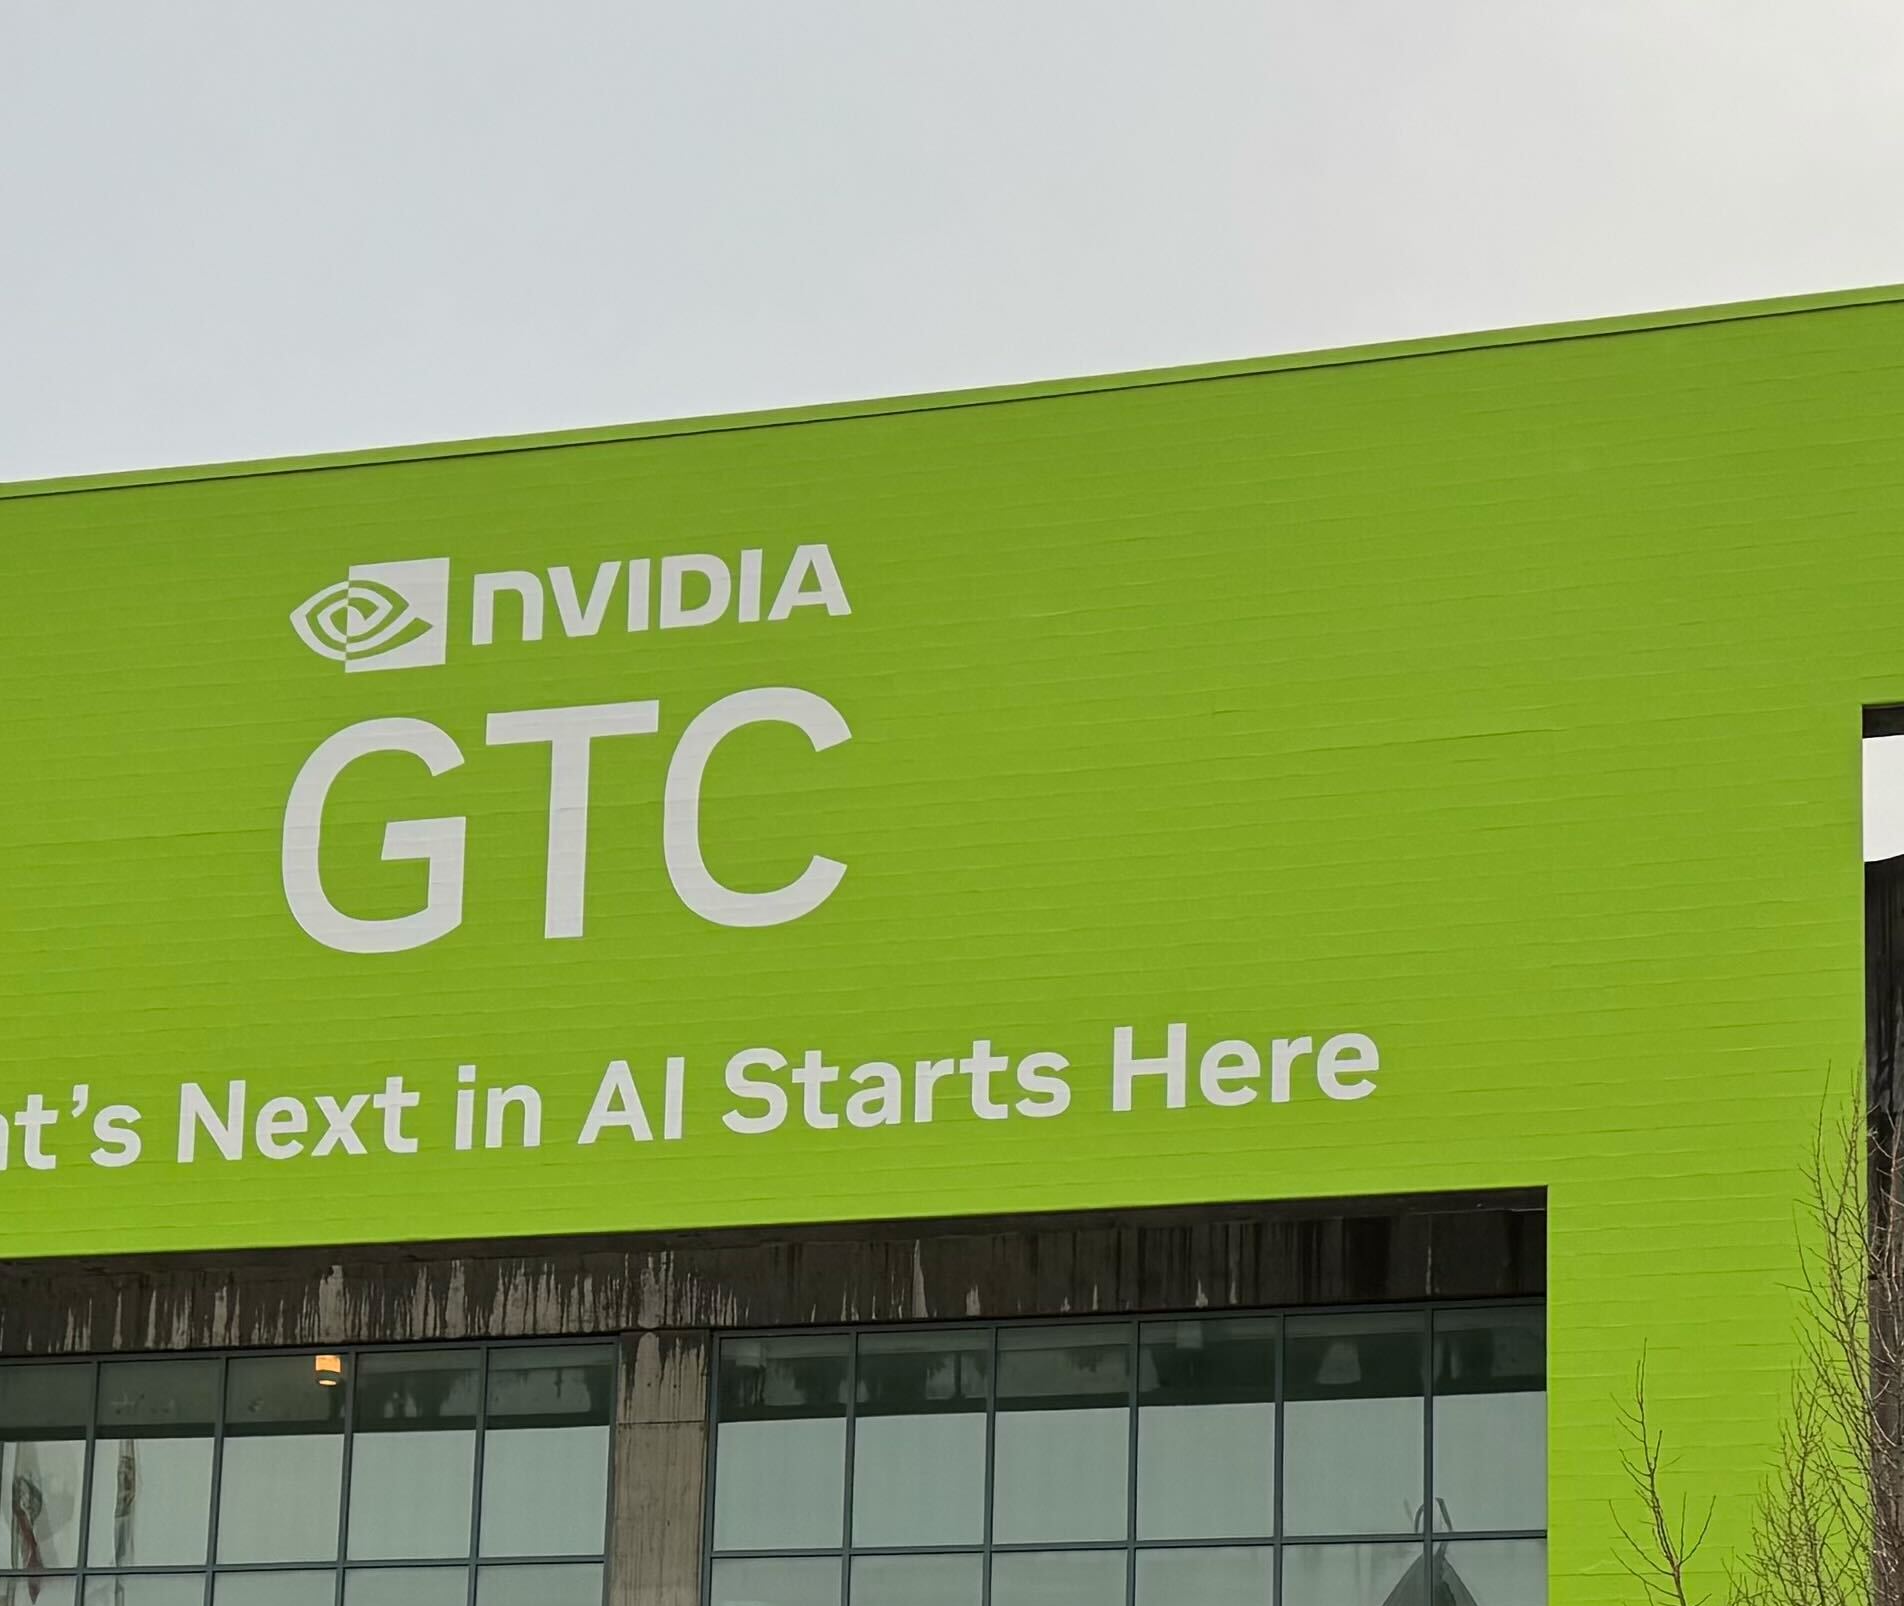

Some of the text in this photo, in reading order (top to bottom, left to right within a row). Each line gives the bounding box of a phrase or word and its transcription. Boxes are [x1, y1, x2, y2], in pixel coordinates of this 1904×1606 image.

[281, 686, 853, 954] GTC
[176, 1075, 421, 1164] Next
[454, 1063, 542, 1152] in
[577, 1056, 686, 1146] AI
[721, 1039, 1072, 1135] Starts
[1111, 1022, 1380, 1112] Here
